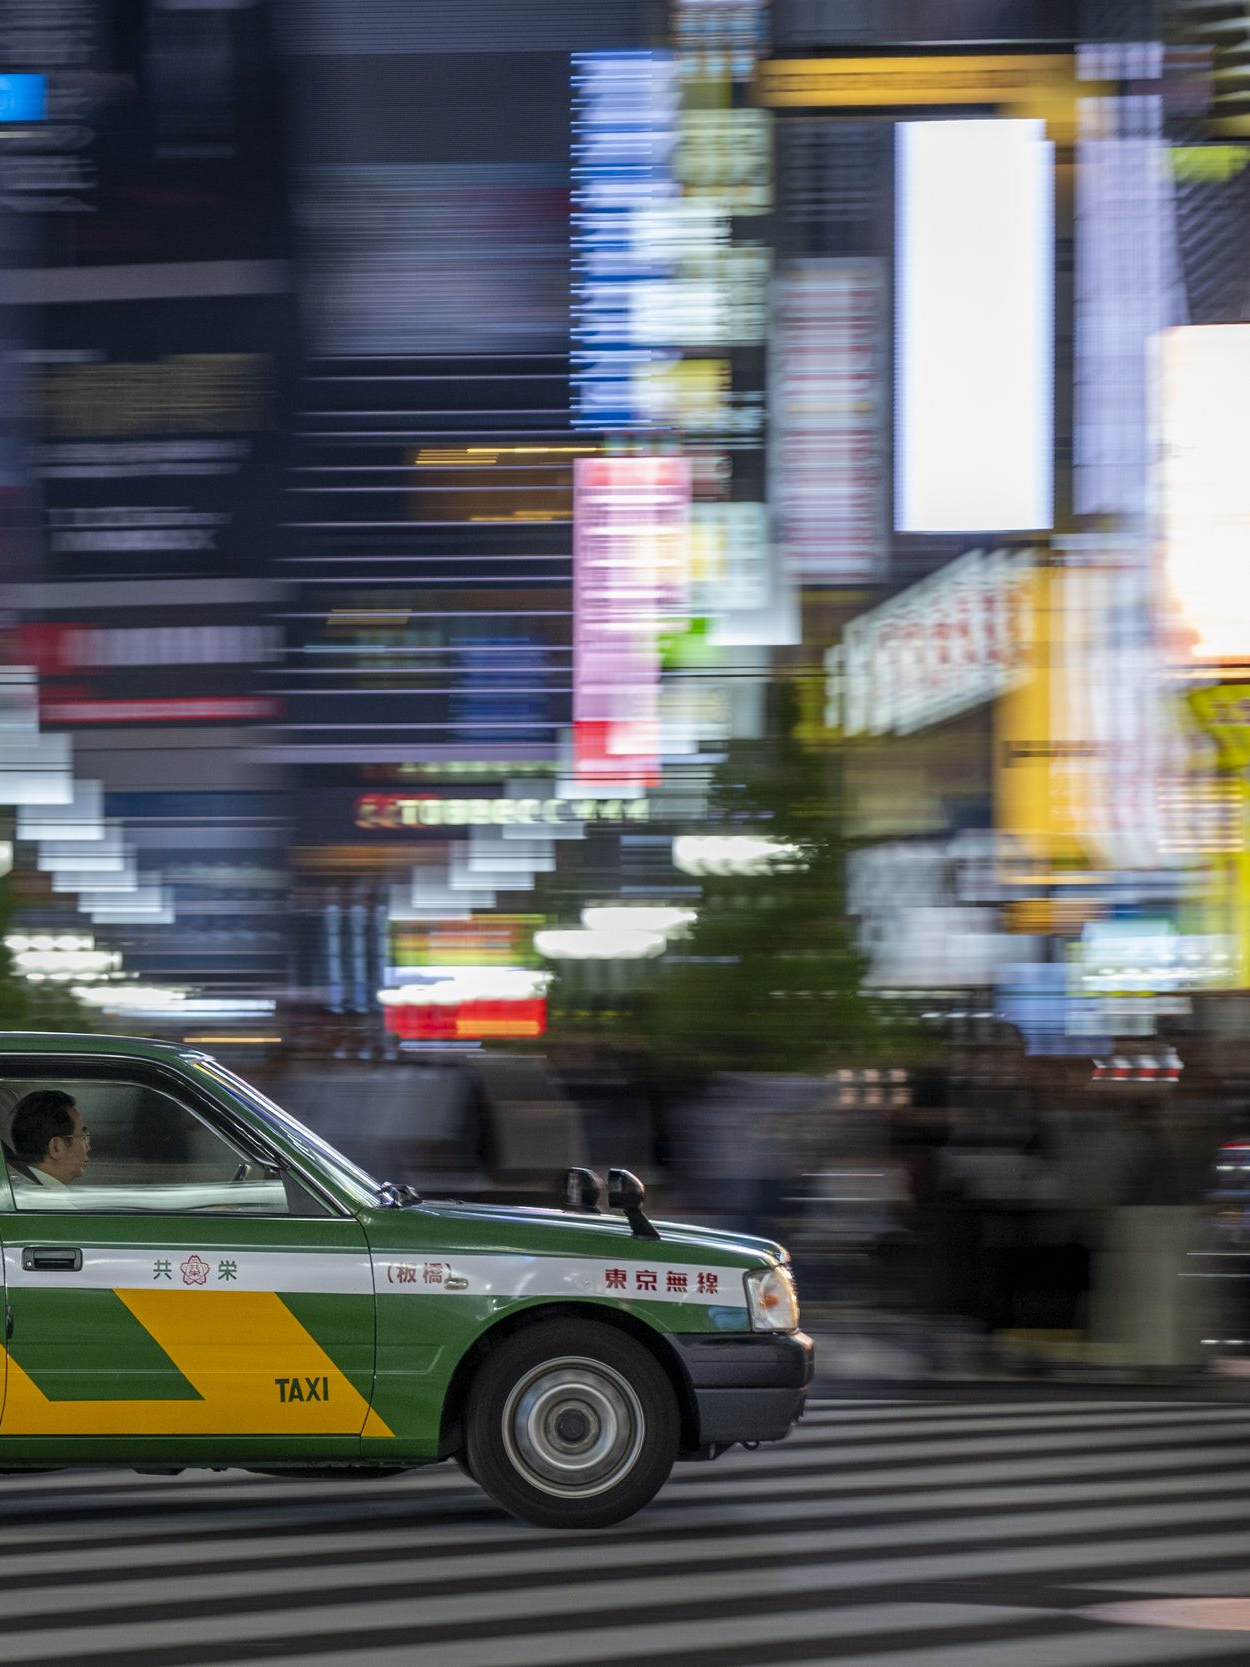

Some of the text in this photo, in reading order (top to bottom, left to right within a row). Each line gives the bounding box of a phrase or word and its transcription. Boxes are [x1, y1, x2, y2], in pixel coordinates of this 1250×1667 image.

[605, 1268, 718, 1294] 東京無線
[275, 1376, 329, 1403] TAXI
